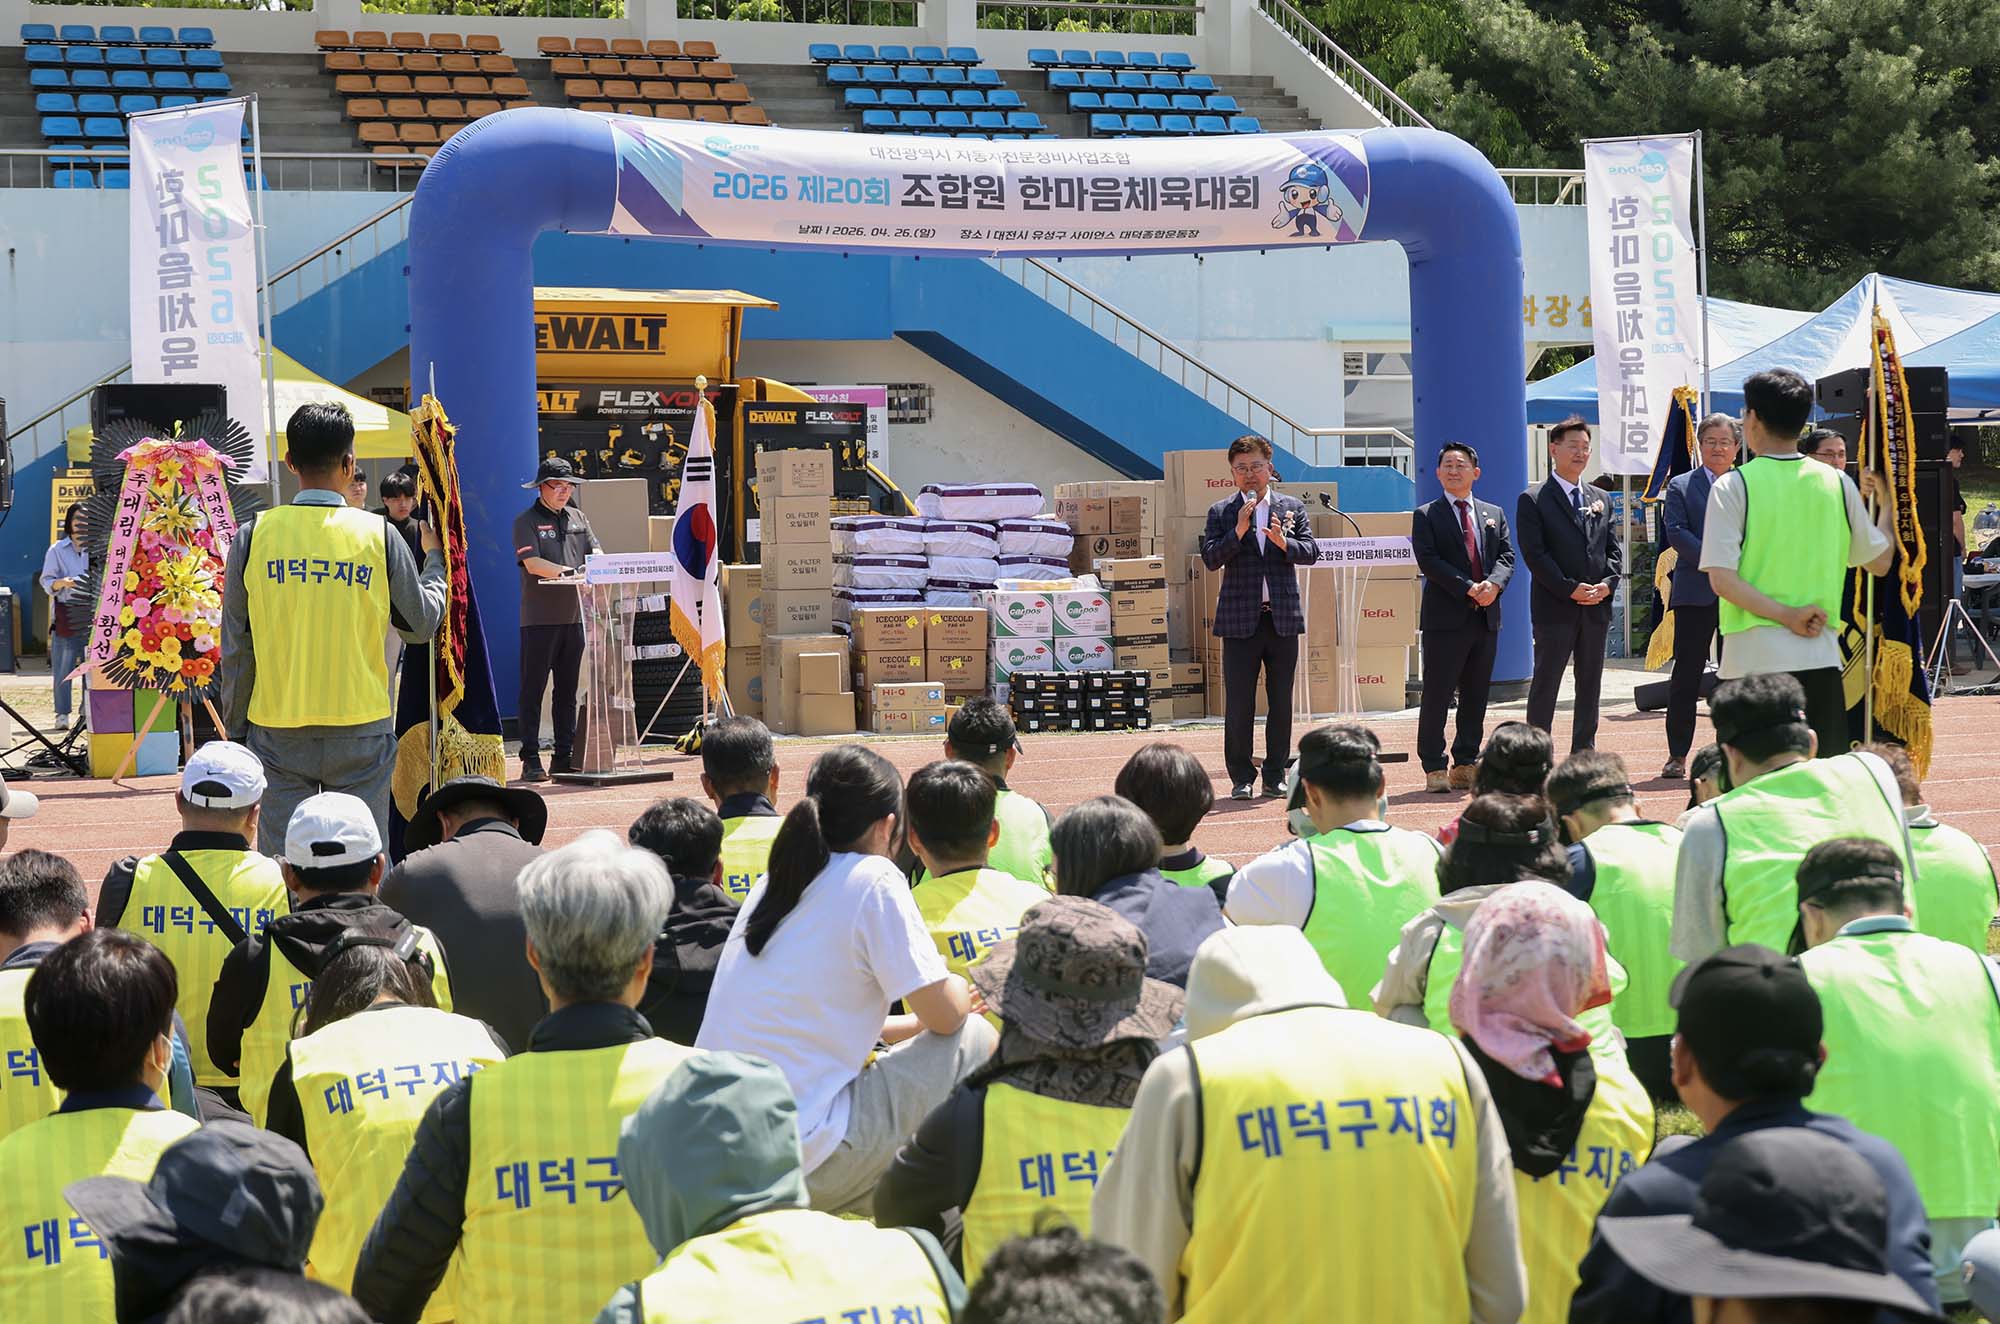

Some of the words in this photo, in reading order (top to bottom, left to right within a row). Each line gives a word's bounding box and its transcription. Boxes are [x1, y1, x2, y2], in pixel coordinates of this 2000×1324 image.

[869, 145, 951, 162] 대전광역시
[712, 171, 789, 201] 2026
[797, 174, 890, 206] 제20회
[901, 173, 1005, 211] 조합원
[1018, 175, 1260, 212] 한마음체육대회
[798, 224, 823, 236] 날짜
[832, 225, 867, 237] 2026.
[870, 227, 891, 237] 04.
[894, 227, 936, 239] 26.(일)
[960, 229, 983, 240] 장소
[993, 230, 1029, 241] 대전시
[1032, 229, 1067, 241] 유성구
[1070, 229, 1115, 241] 사이언스
[1119, 228, 1200, 240] 대덕종합운동장
[534, 316, 668, 350] EWALT
[537, 391, 580, 412] ALT
[749, 411, 797, 423] DEWALT
[805, 411, 862, 421] FLEXVOLT
[58, 486, 96, 496] DEWA
[798, 511, 819, 519] FILTER
[1115, 537, 1138, 549] Eagle
[1346, 548, 1411, 560] 한마음체육대회
[800, 558, 821, 566] FILTER
[107, 546, 128, 607] 대표이사
[266, 558, 374, 591] 대덕구지회
[791, 613, 817, 621] 오일필터
[1361, 608, 1396, 618] Tefal
[882, 688, 905, 696] Hi-Q
[884, 712, 908, 720] Hi-Q
[948, 927, 1019, 961] 대덕
[1236, 1095, 1458, 1158] 대덕구지회
[1019, 1150, 1103, 1198] 대덕
[495, 1157, 625, 1210] 대덕구
